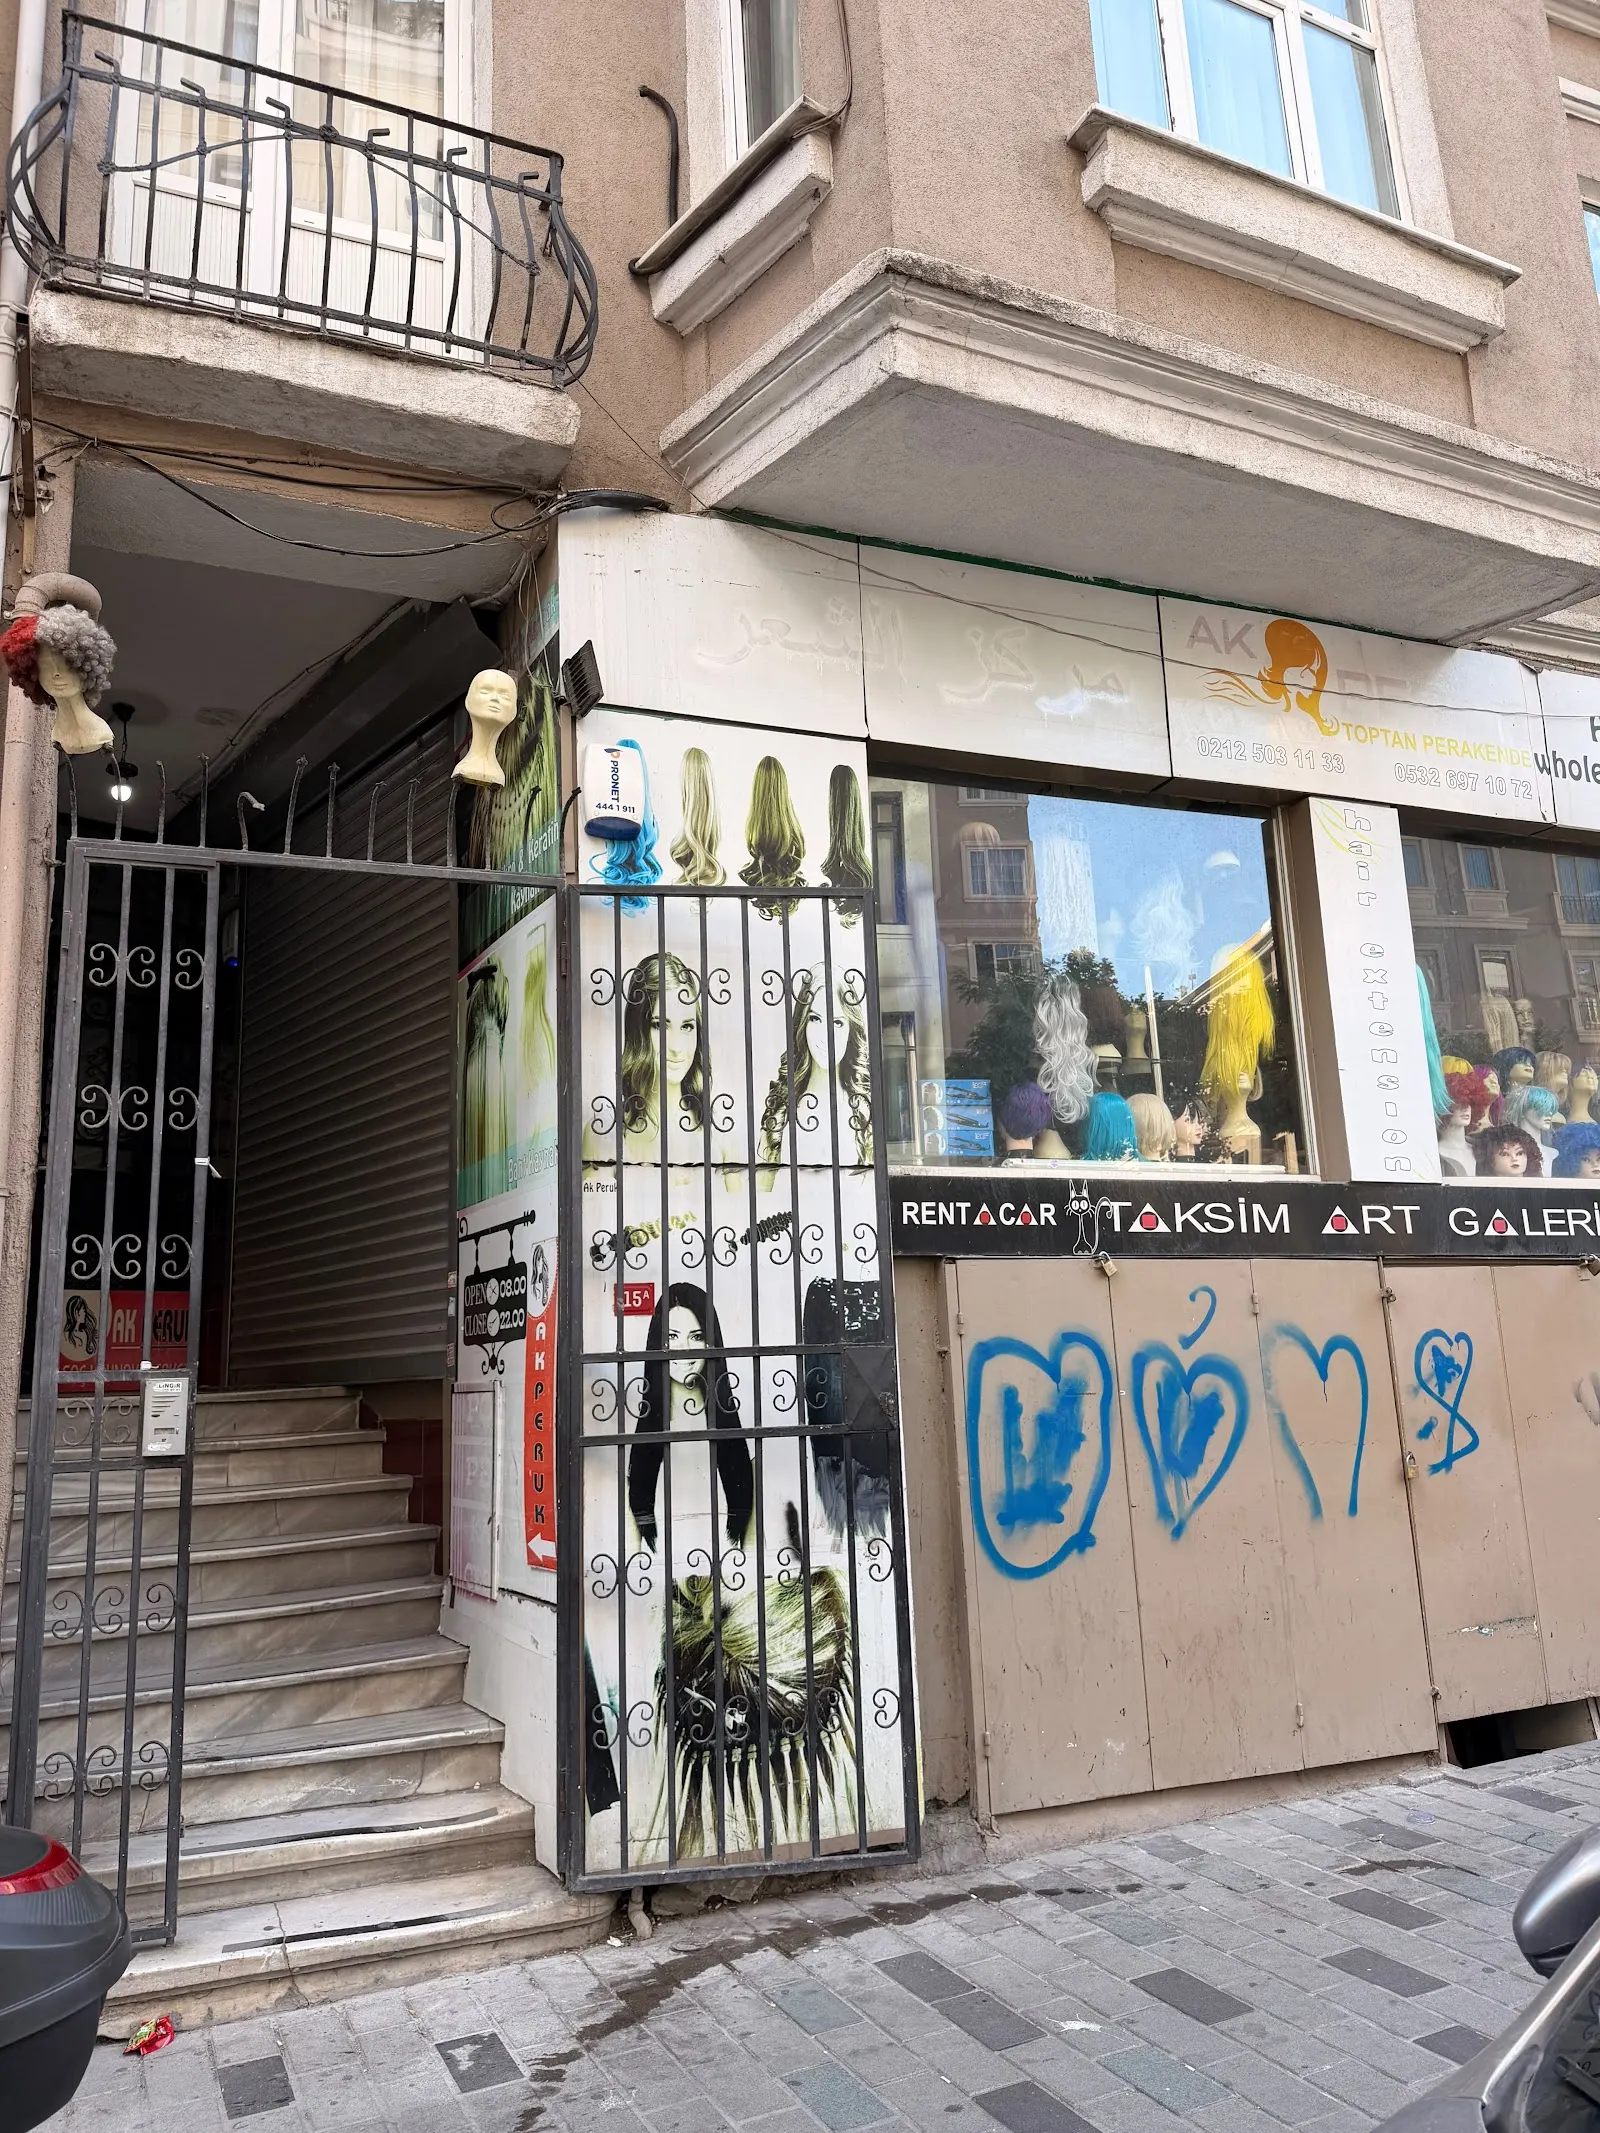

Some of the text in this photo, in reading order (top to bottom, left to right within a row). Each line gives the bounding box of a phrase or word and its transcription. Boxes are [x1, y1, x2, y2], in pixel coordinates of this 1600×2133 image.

[1186, 615, 1258, 660] AK
[1197, 736, 1345, 773] 0212 503 11 33
[1341, 722, 1532, 768] TOPTAN PERAKENDE
[611, 760, 620, 802] PRONET
[1394, 763, 1533, 799] 0532 697 10 72
[595, 802, 635, 813] 444 1 911
[528, 821, 559, 864] Keratin
[1344, 809, 1377, 907] hair
[583, 1183, 594, 1192] Ak
[1100, 1197, 1291, 1234] TAKSİM
[1321, 1204, 1421, 1235] ART
[464, 1275, 526, 1307] OPEN 08.00
[112, 1308, 189, 1343] AK ERU
[464, 1307, 525, 1337] CLOSE 22.00
[532, 1321, 546, 1525] AK PERUK
